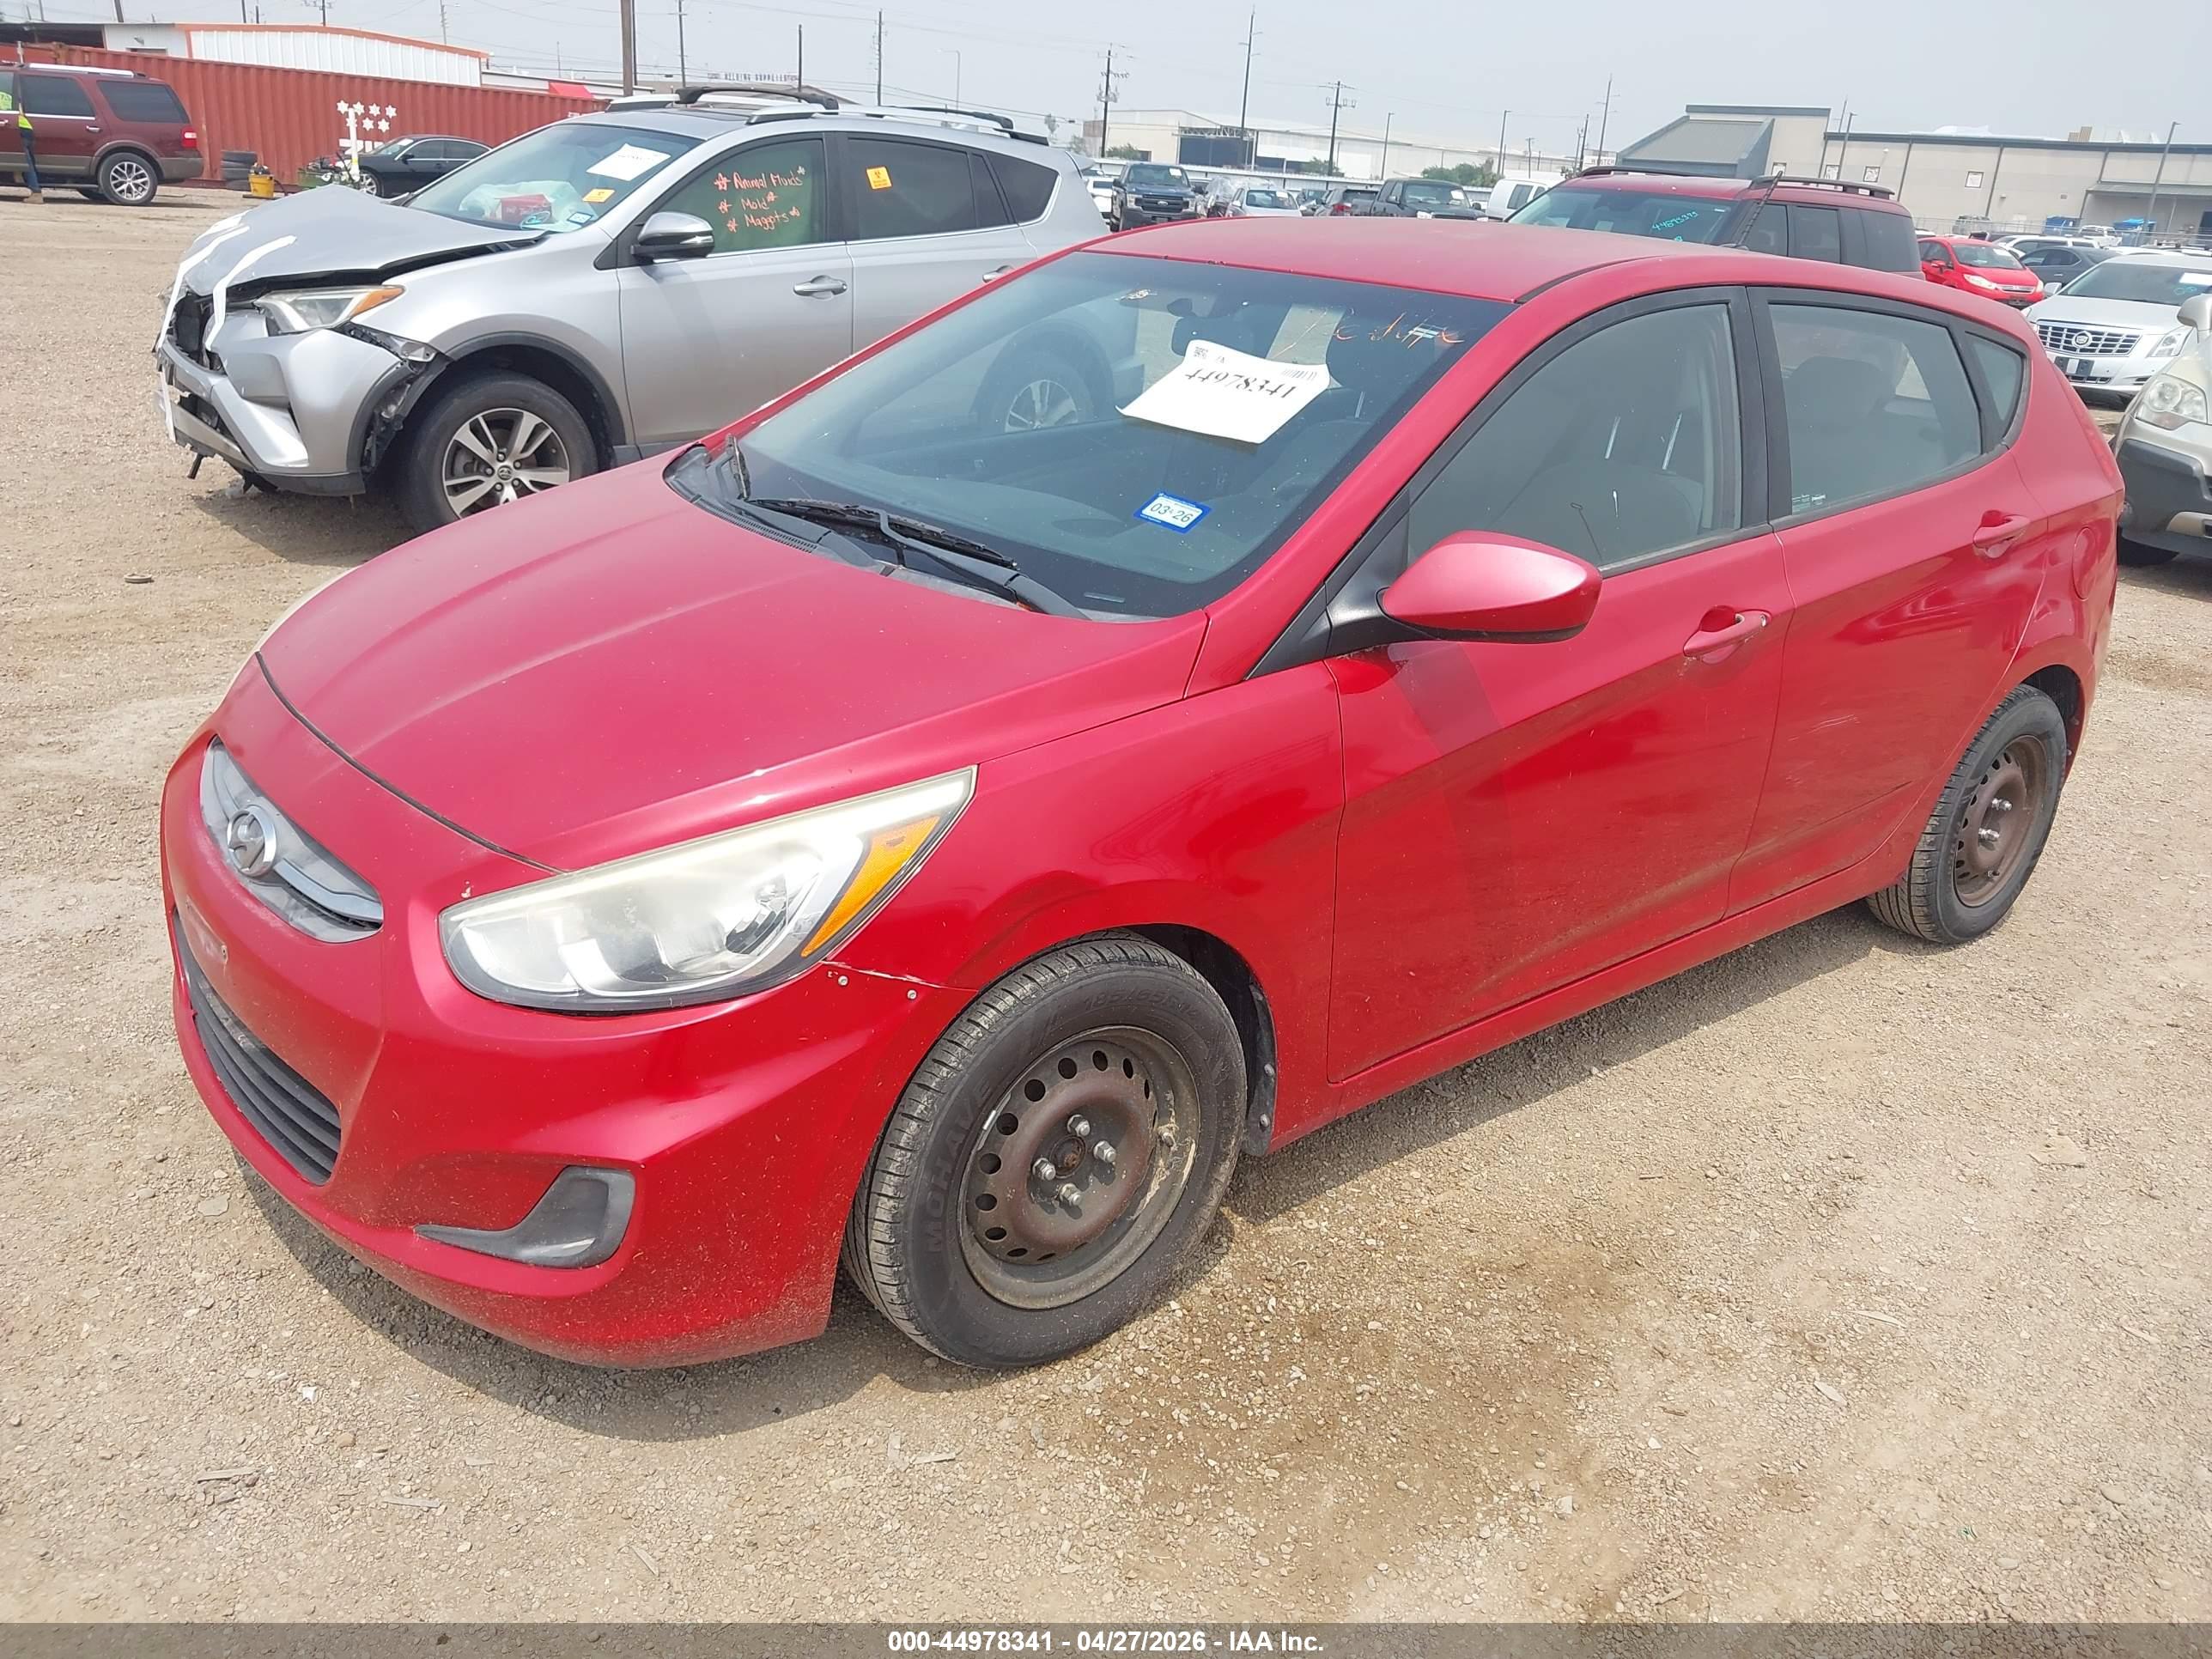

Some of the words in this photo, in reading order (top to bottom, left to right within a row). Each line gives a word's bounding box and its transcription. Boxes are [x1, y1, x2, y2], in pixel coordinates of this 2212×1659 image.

[733, 172, 767, 189] Animal
[741, 198, 769, 211] Mold
[744, 211, 789, 230] Maggots
[1185, 368, 1297, 398] 44978341
